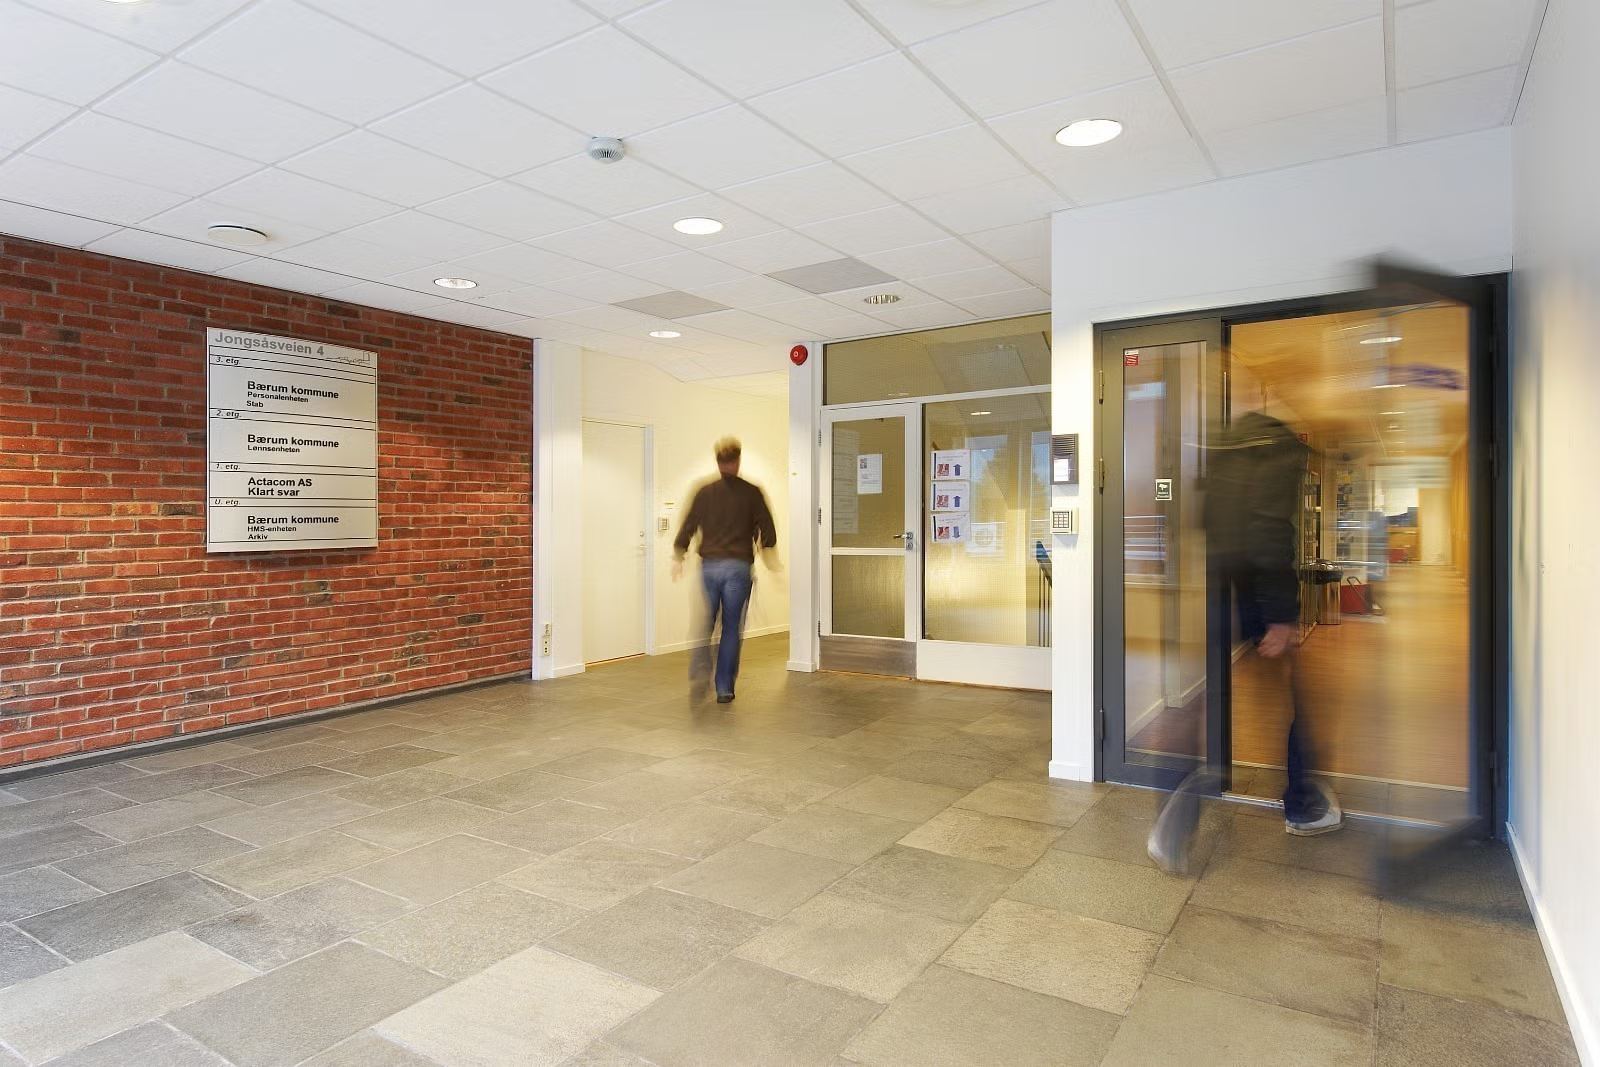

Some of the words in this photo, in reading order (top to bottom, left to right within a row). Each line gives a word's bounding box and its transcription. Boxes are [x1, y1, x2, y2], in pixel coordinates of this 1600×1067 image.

[215, 332, 312, 354] Jongsåsveien
[316, 346, 325, 356] 4
[226, 358, 241, 366] etg.
[247, 381, 288, 393] Bærum
[291, 385, 339, 399] kommune
[247, 391, 309, 403] Personalenheten
[246, 400, 264, 408] Stab
[247, 434, 288, 445] Bærum
[291, 437, 339, 448] kommune
[247, 445, 300, 453] Lønnsenheten
[248, 477, 296, 487] Actacom
[298, 478, 312, 487] AS
[248, 487, 274, 496] Klart
[225, 499, 241, 507] etg.
[247, 515, 288, 524] Bærum
[291, 515, 339, 524] kommune
